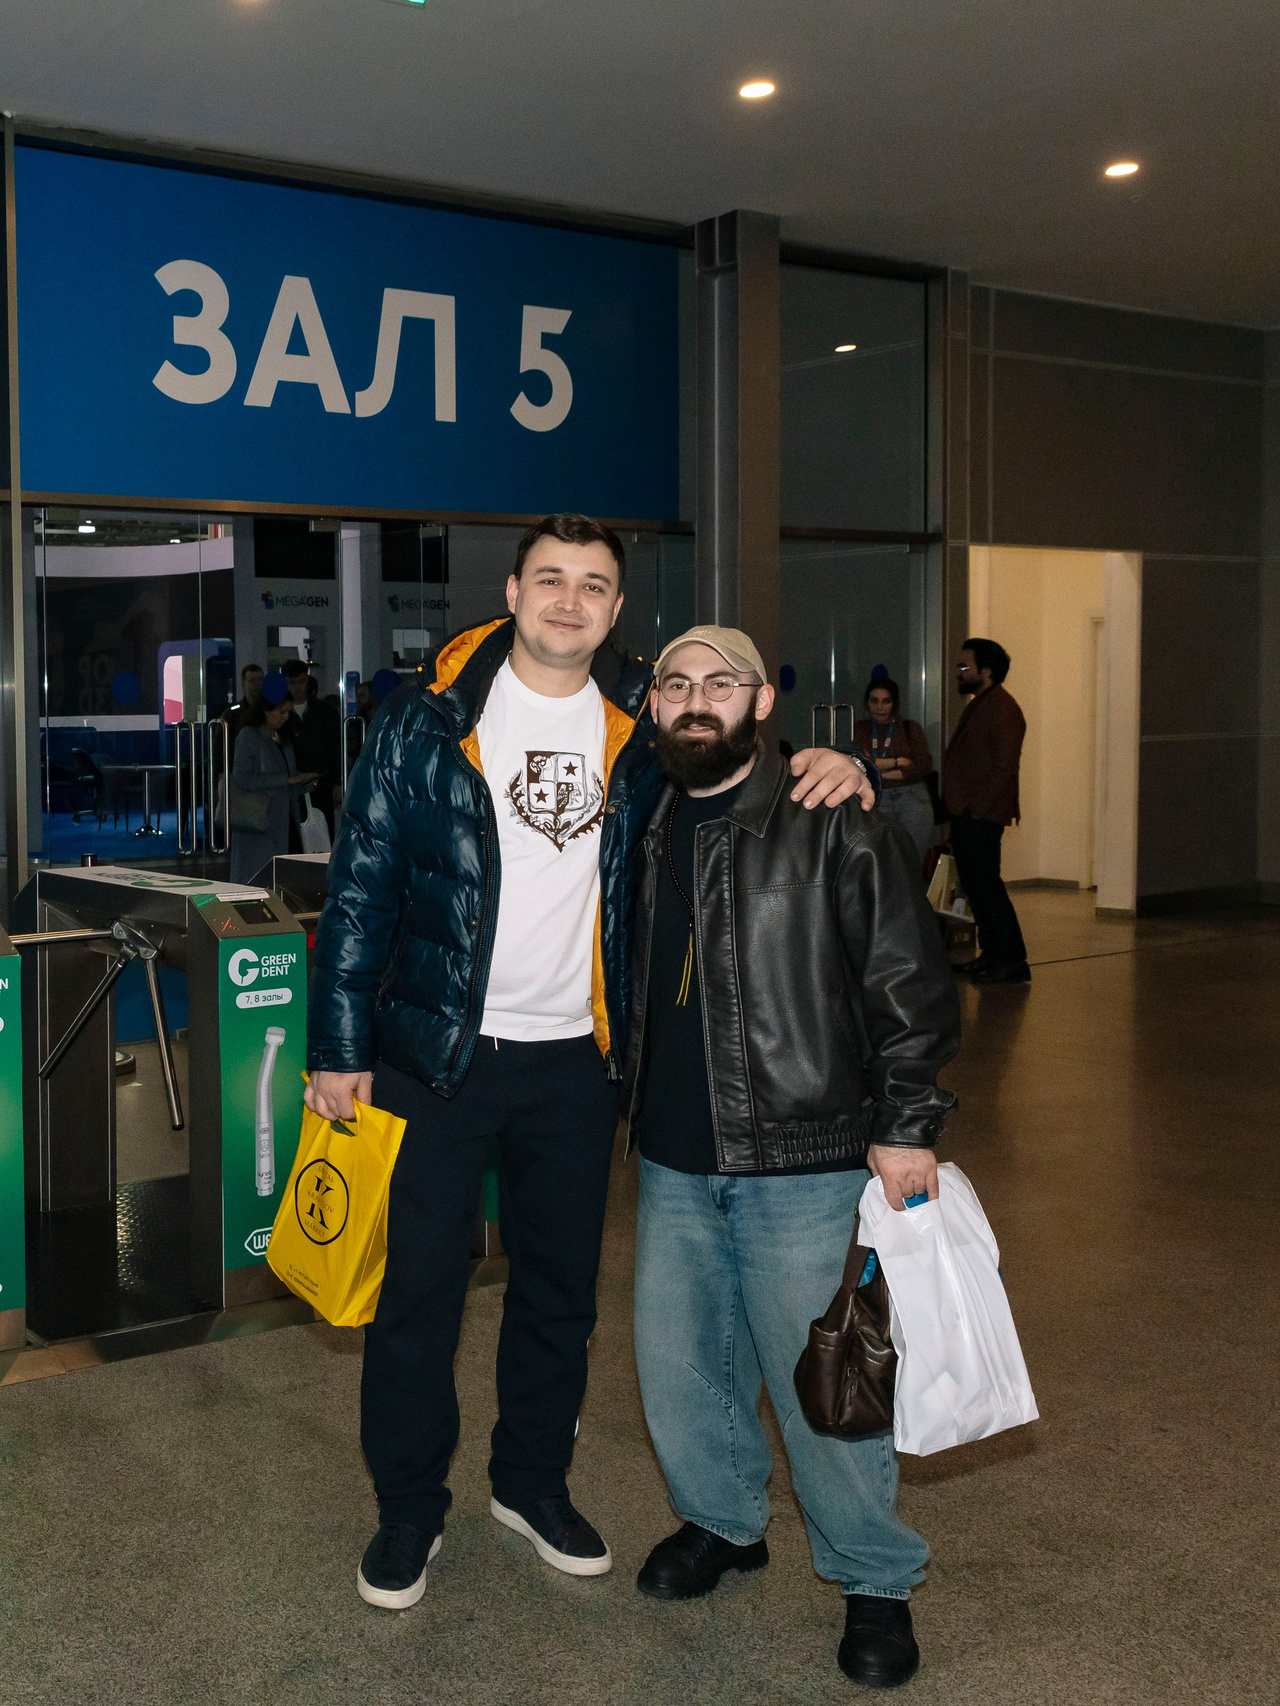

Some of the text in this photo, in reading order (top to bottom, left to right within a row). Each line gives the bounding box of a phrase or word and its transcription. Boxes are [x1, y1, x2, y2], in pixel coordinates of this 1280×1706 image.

[152, 259, 574, 432] ЗАЛ 5
[261, 953, 296, 966] GREEN
[261, 965, 290, 978] DENT
[245, 994, 283, 1004] 7, 8 залы
[304, 1218, 325, 1238] MARKET
